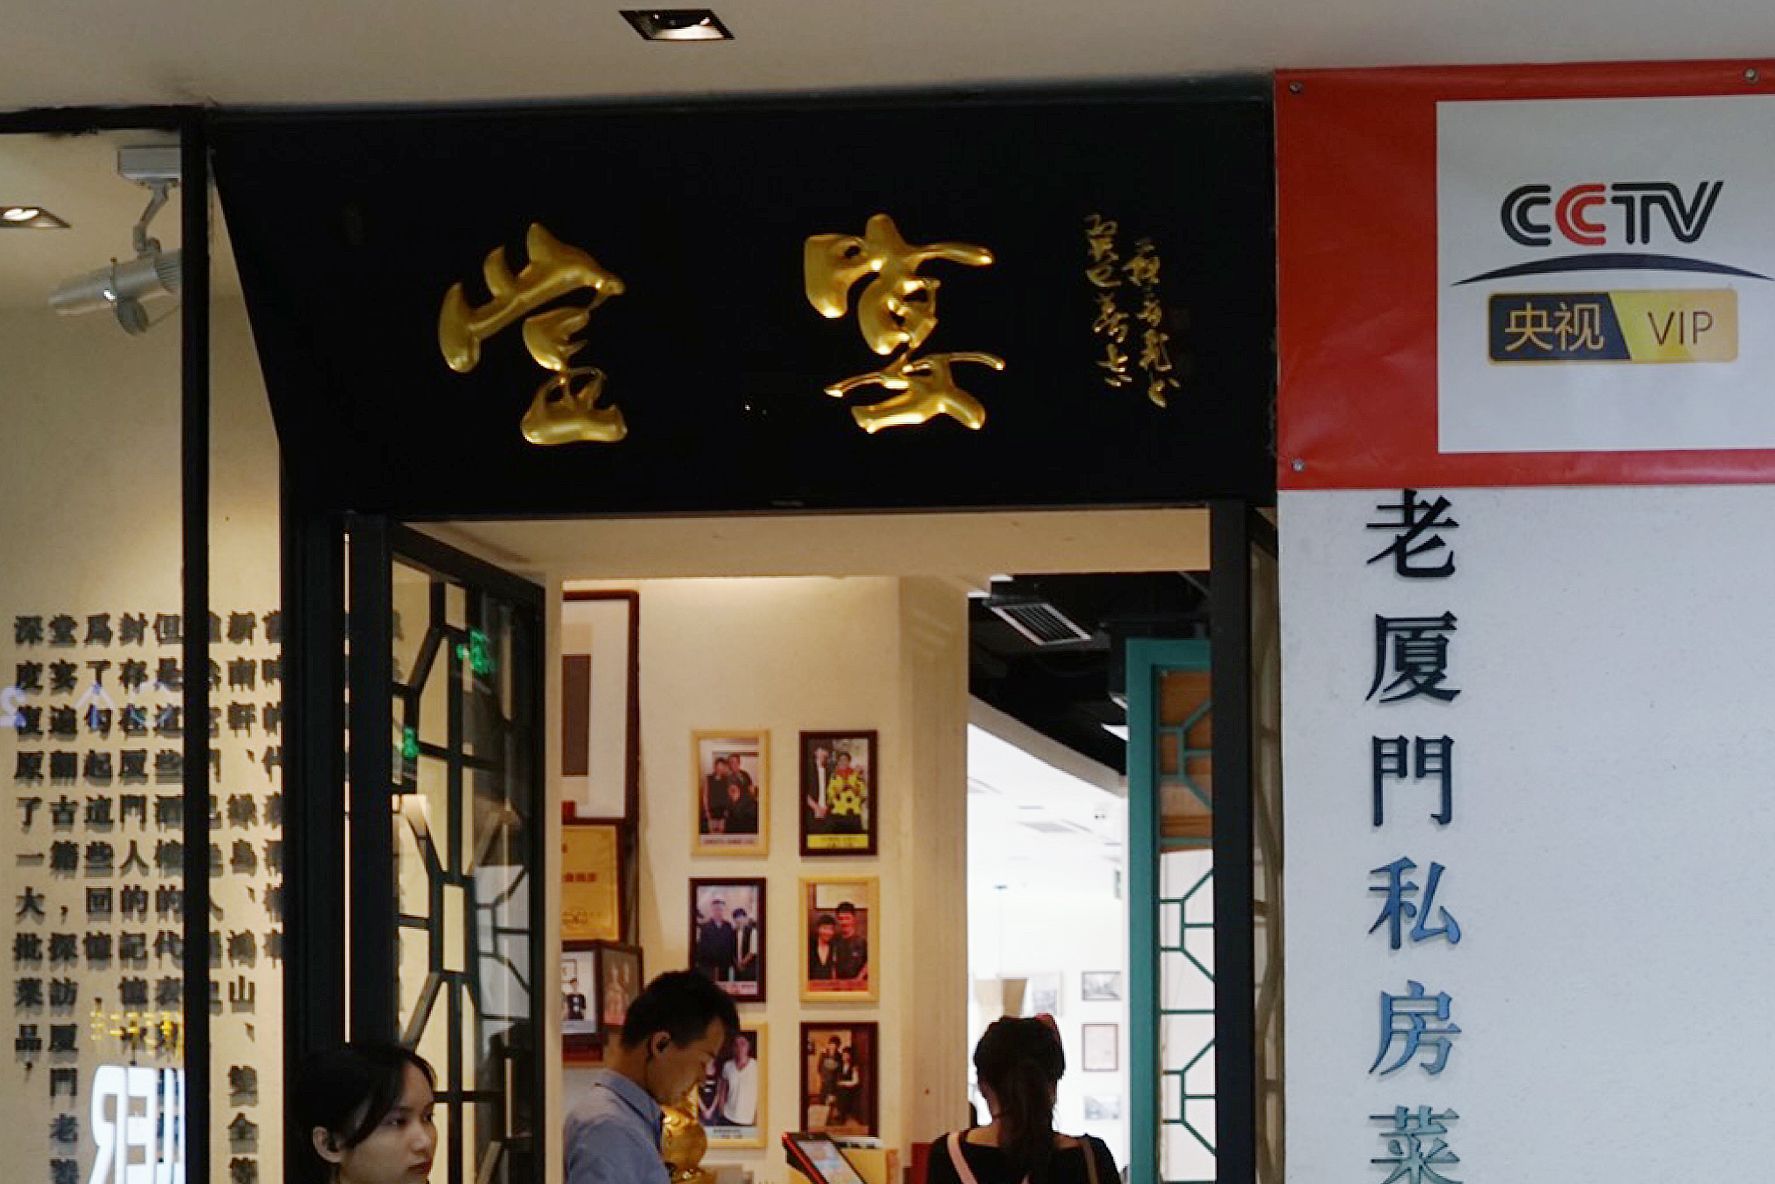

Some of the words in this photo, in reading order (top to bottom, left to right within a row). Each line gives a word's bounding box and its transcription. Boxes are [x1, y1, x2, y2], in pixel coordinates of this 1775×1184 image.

[1501, 180, 1724, 246] CCTV
[1505, 302, 1606, 351] 央视
[1647, 310, 1714, 347] VIP
